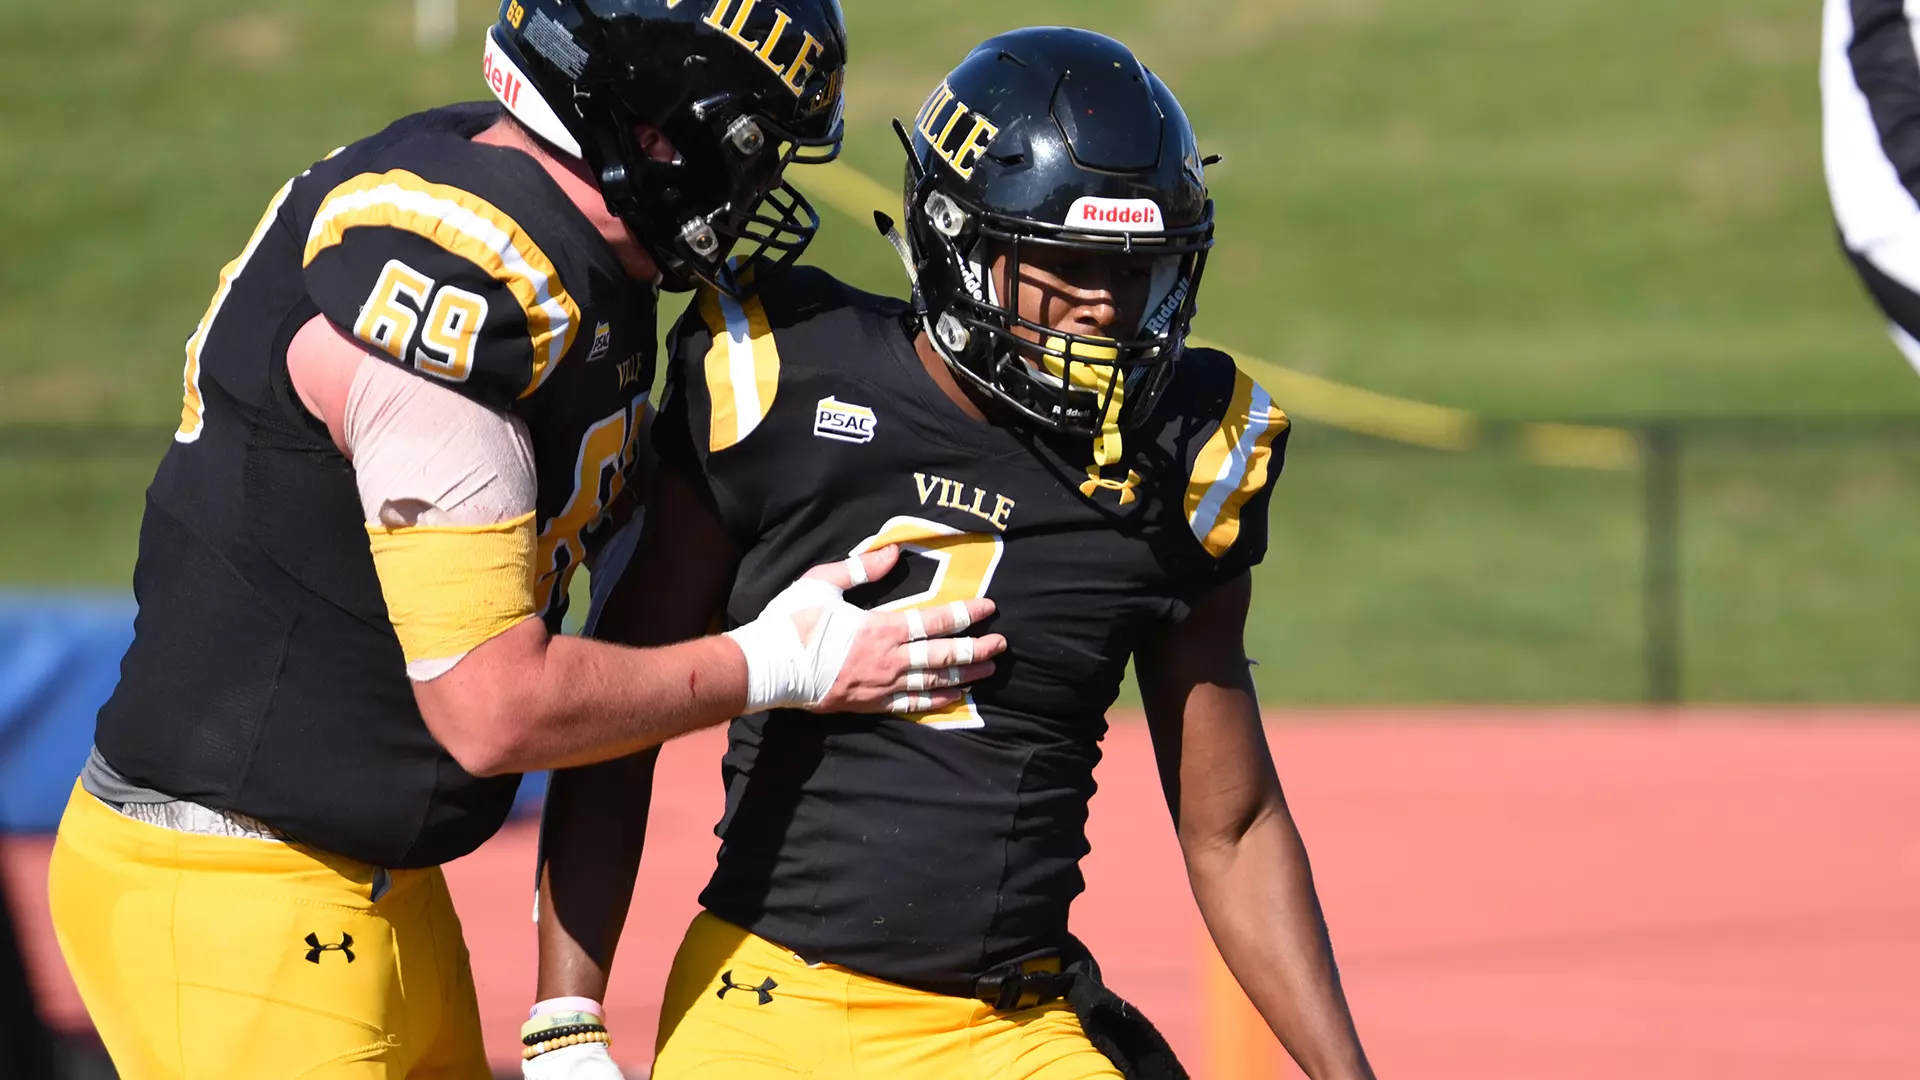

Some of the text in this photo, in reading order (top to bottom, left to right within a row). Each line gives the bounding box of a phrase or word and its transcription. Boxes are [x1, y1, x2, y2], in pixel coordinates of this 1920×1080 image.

[506, 0, 524, 29] 69
[667, 0, 823, 97] ILLE
[483, 52, 521, 109] dell
[914, 78, 999, 180] ILLE
[1082, 203, 1155, 223] Riddell
[353, 259, 489, 383] 69
[819, 410, 871, 432] PSAC
[1052, 404, 1091, 417] Rddell
[913, 472, 1016, 531] VILLE
[849, 515, 1004, 730] 2
